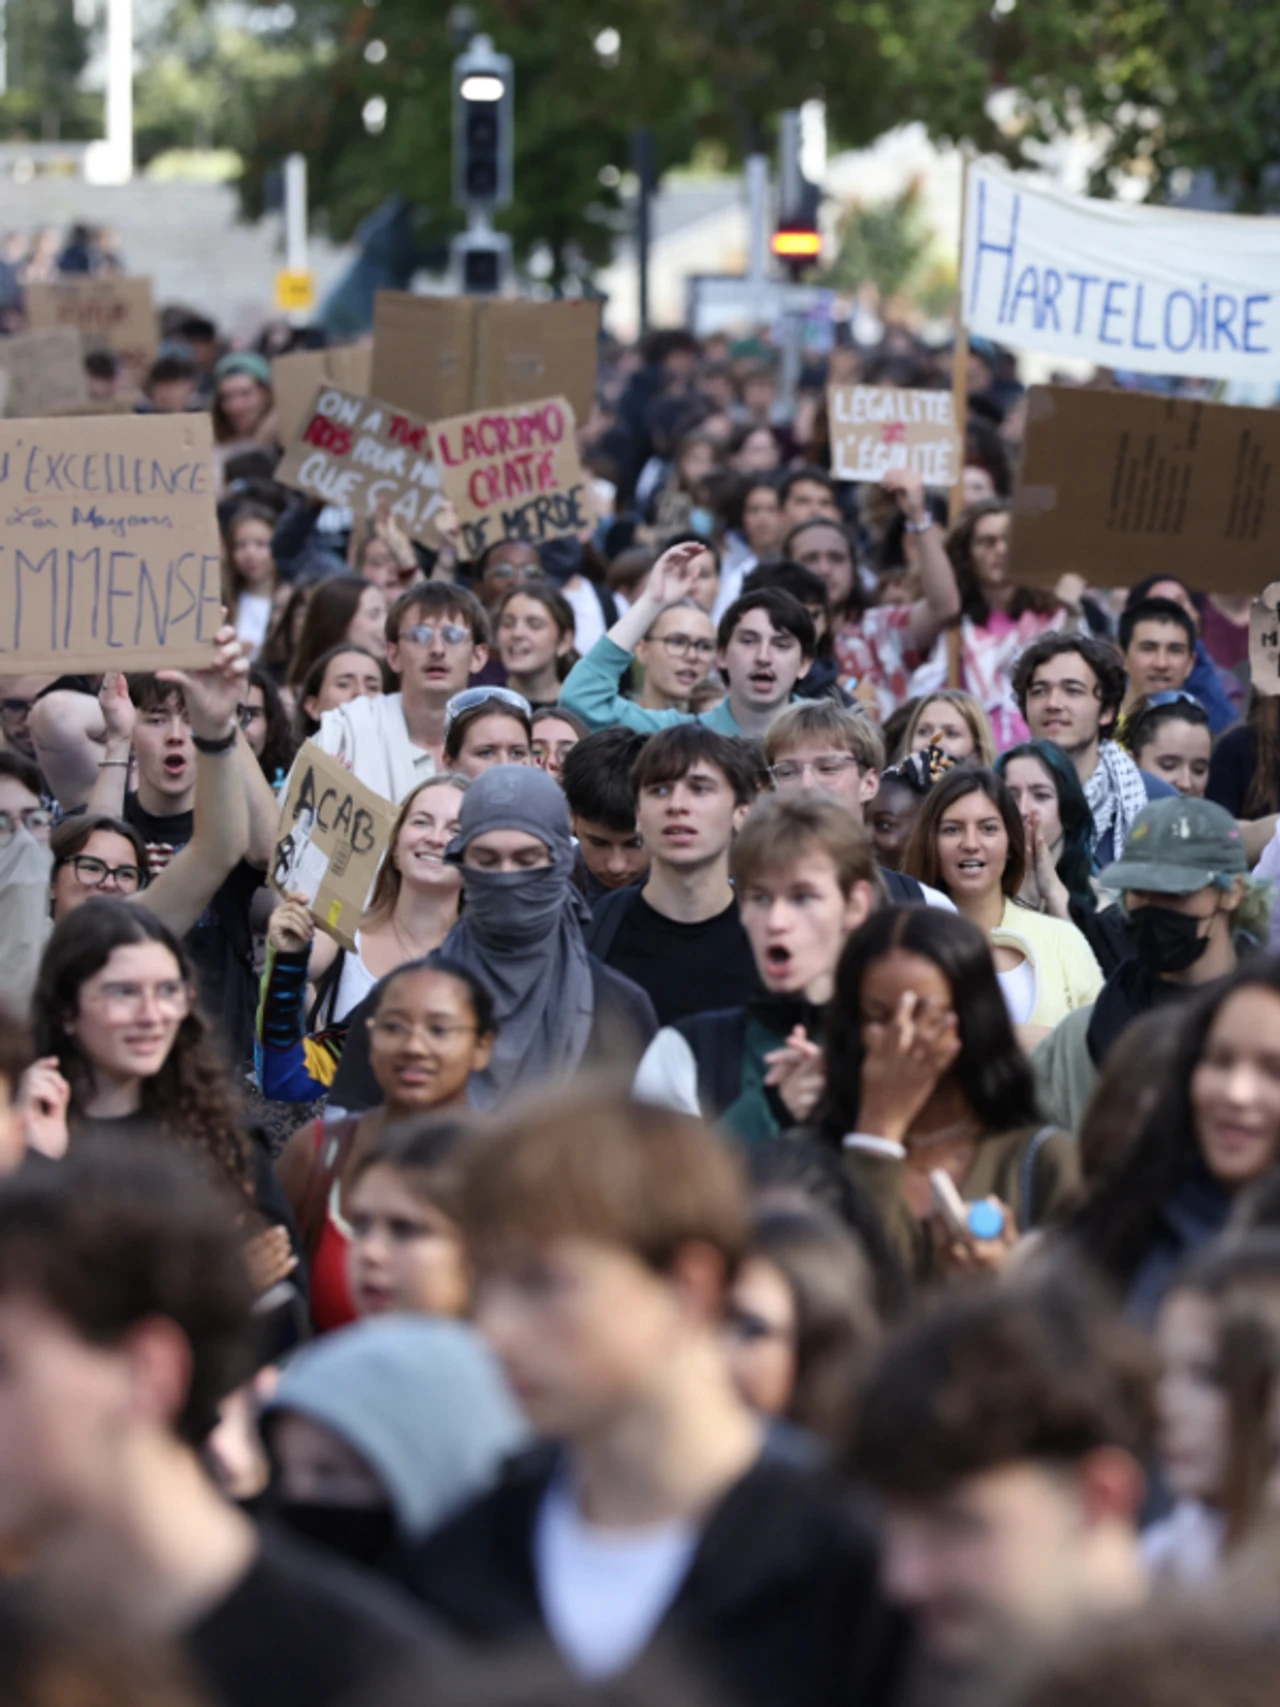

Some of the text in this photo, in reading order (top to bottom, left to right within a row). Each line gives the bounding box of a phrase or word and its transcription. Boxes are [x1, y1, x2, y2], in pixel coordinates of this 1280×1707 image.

[970, 179, 1271, 354] HARTELOIRE
[317, 391, 363, 425] ON
[361, 410, 383, 433] A
[437, 403, 565, 467] LACRIMO
[500, 483, 589, 543] MERDE
[292, 765, 376, 856] ACAB
